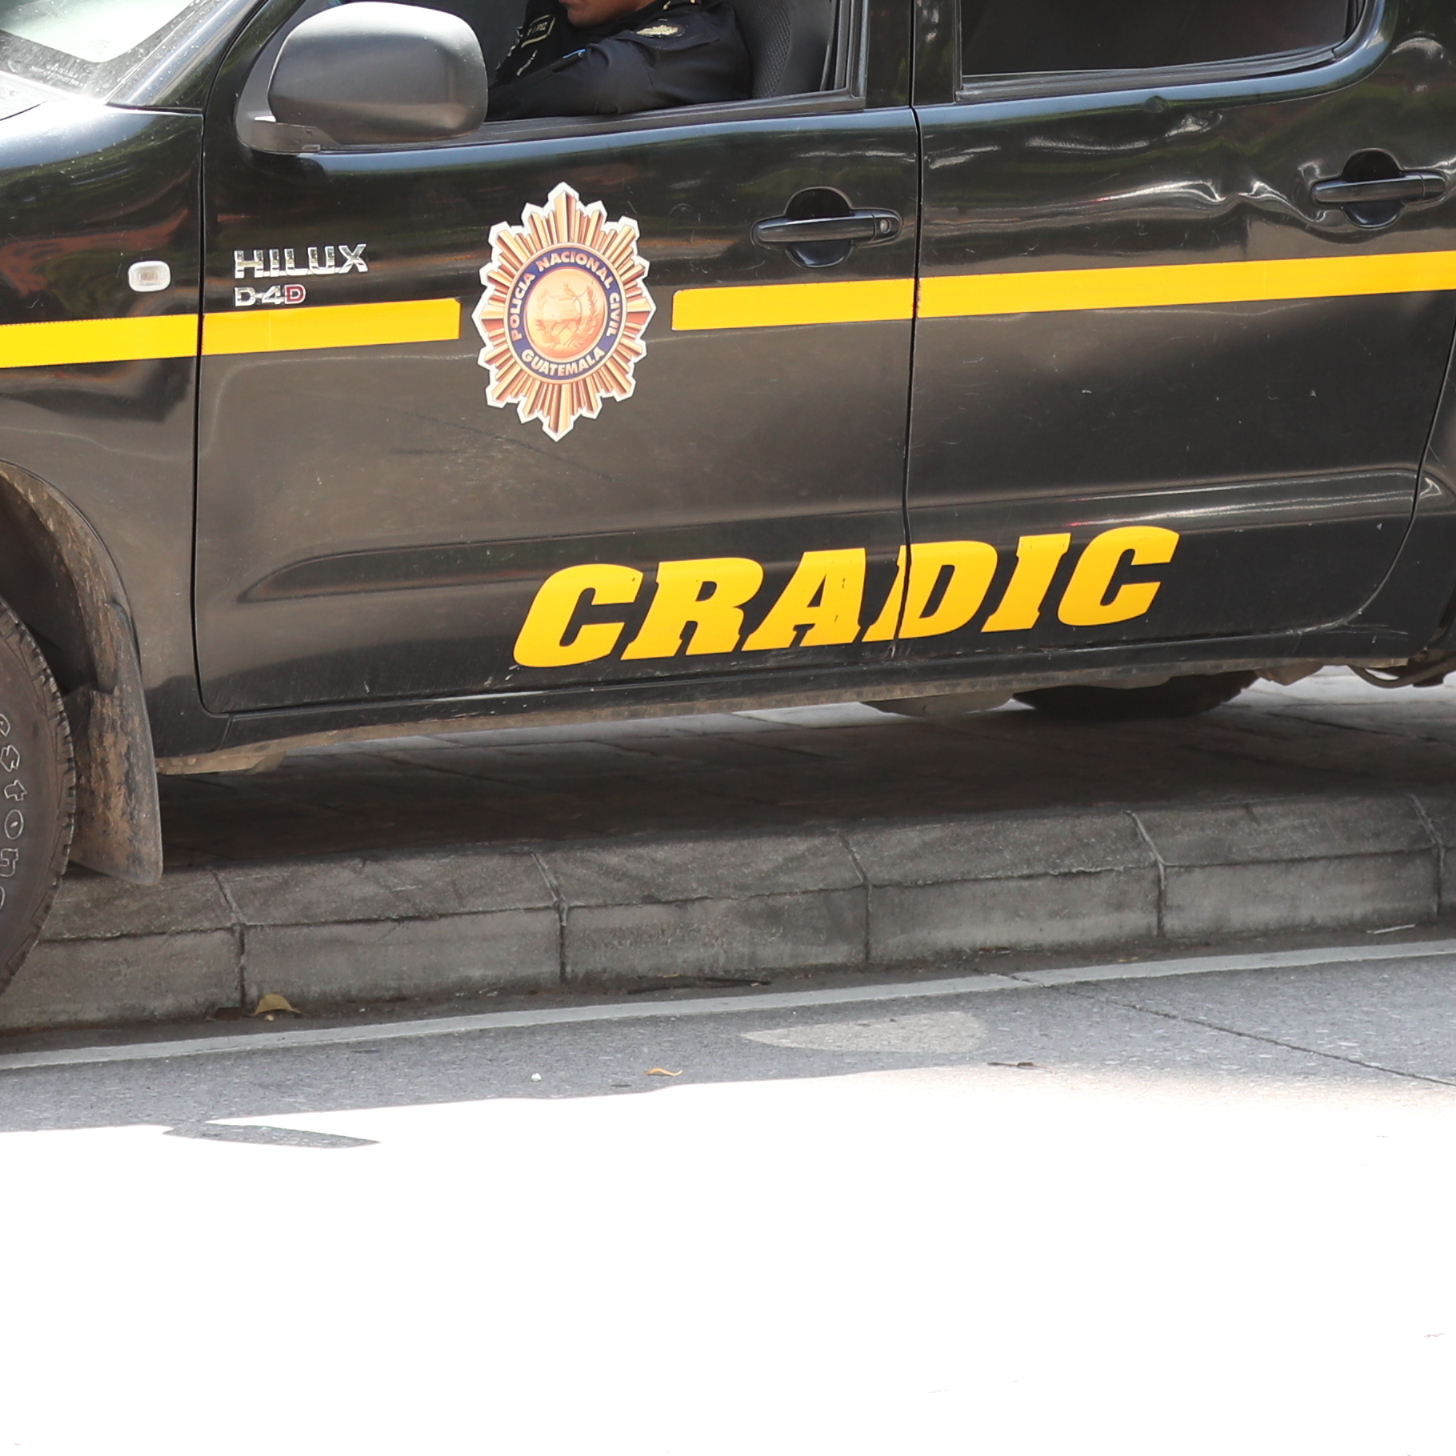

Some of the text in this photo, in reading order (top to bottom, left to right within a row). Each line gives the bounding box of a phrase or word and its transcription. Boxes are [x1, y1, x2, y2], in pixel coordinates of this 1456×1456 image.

[233, 243, 369, 279] HILUX
[509, 250, 622, 342] POLICIA NACIONAL CIVIL
[521, 346, 606, 377] GUATEMALA
[512, 525, 1181, 668] CRADIC
